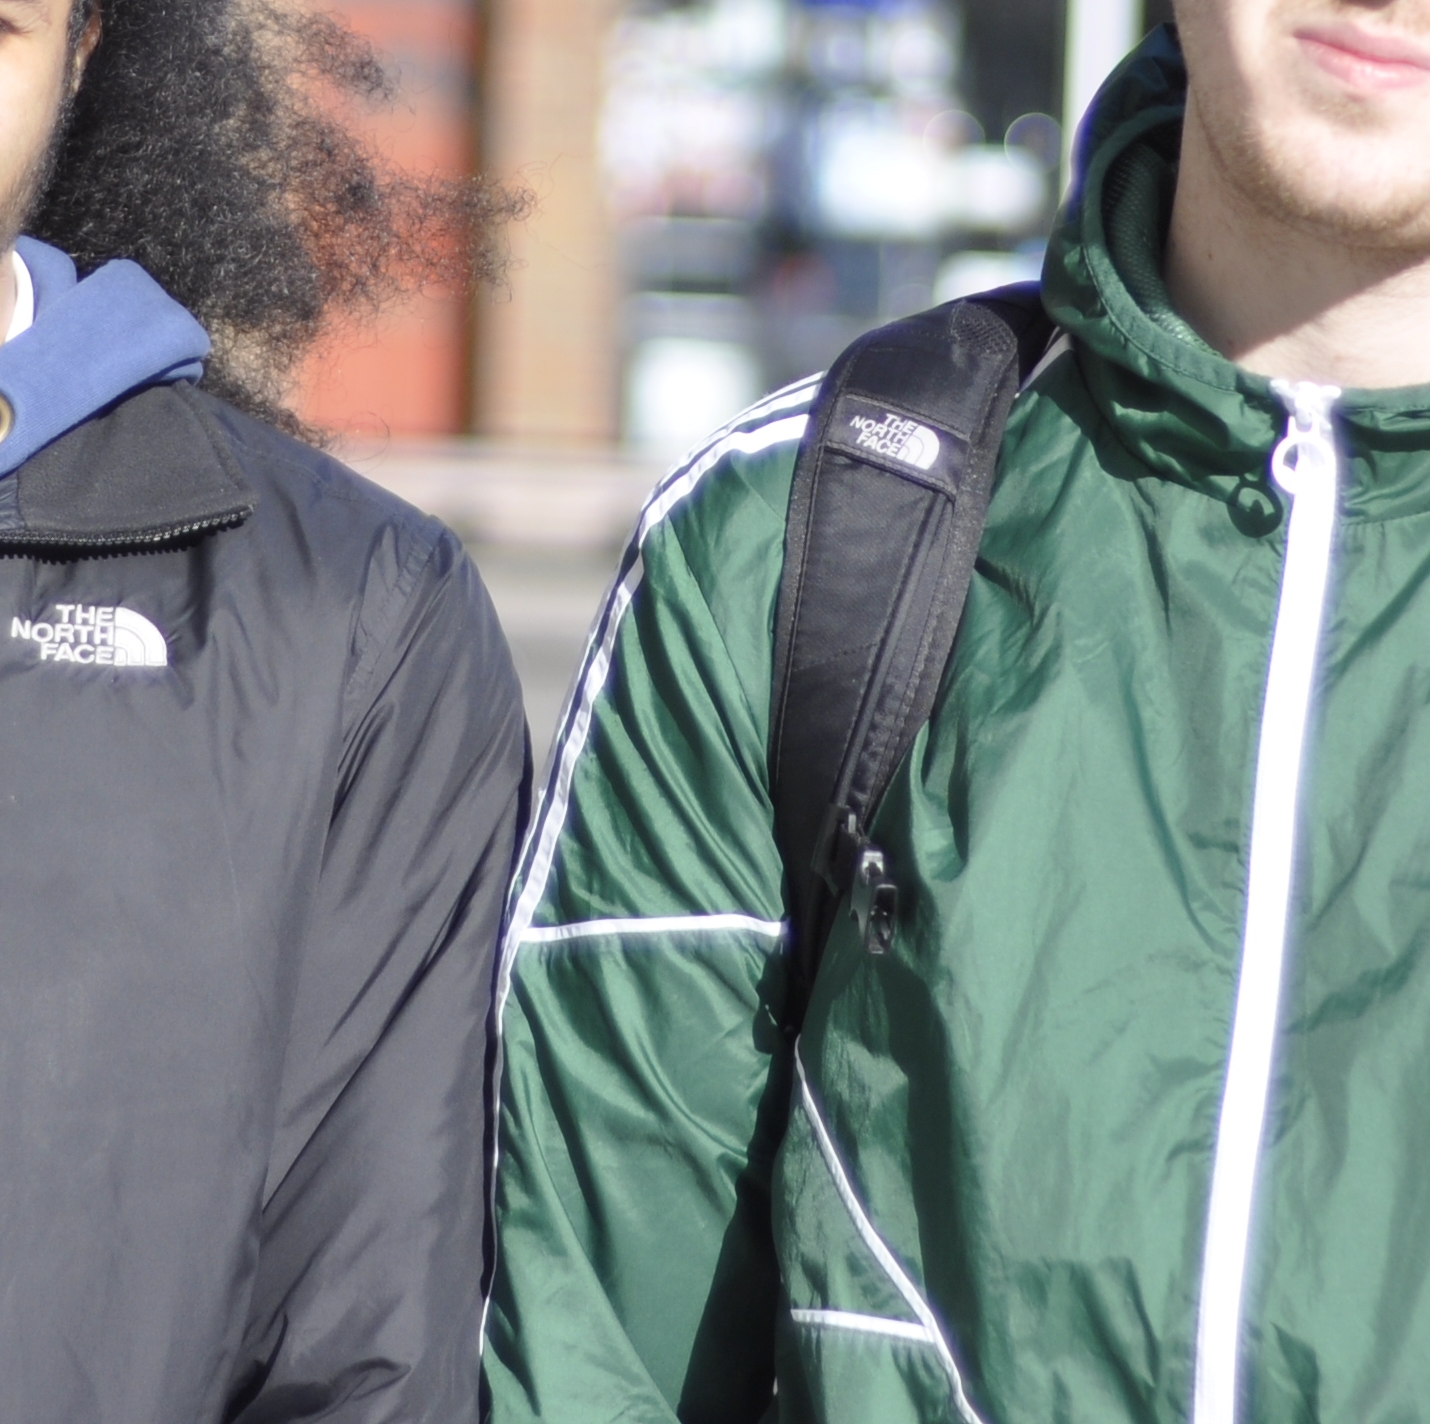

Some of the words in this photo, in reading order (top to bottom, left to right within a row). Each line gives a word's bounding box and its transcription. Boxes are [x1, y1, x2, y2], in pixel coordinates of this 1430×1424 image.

[849, 415, 910, 445] NORTH
[883, 412, 919, 435] THE
[856, 431, 903, 458] FACE
[55, 603, 115, 626] THE
[10, 616, 115, 646] NORTH
[39, 642, 115, 665] FACE
